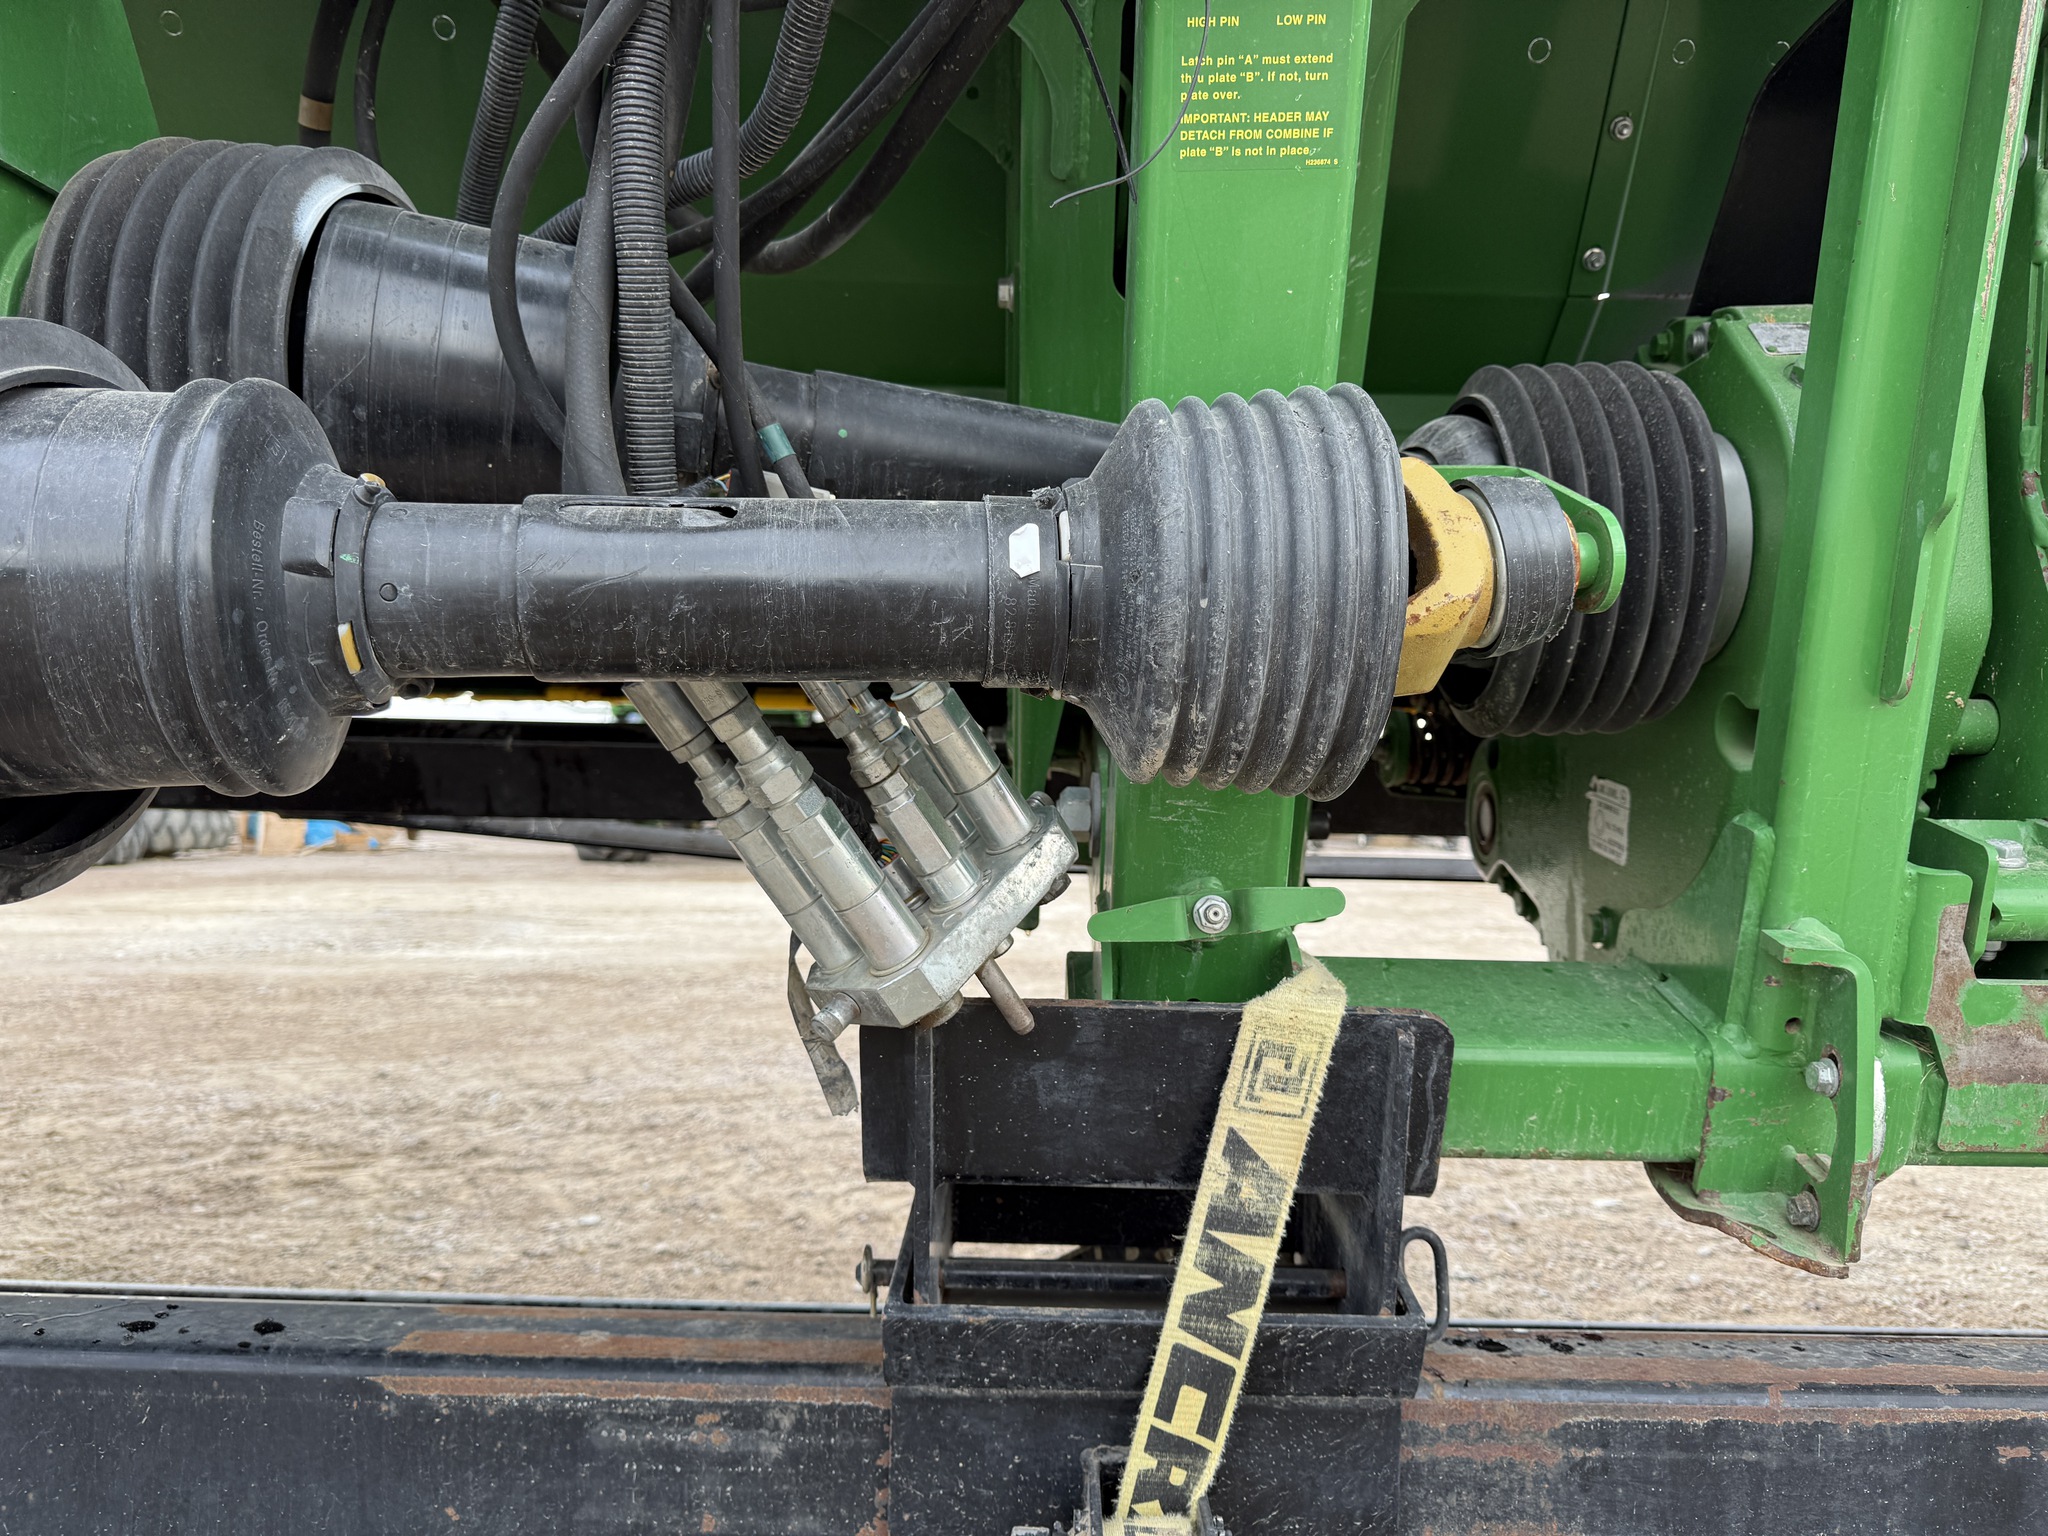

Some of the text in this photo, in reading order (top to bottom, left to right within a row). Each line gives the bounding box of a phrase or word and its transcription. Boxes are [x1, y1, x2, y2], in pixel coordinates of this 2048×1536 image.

[1187, 16, 1239, 27] HIGH PIN
[1277, 14, 1326, 25] LOW PIN
[1182, 56, 1212, 66] Latch
[1217, 55, 1234, 67] pin
[1262, 54, 1290, 64] must
[1294, 54, 1333, 64] extend
[1181, 74, 1204, 83] thu
[1208, 73, 1236, 85] plate
[1268, 71, 1275, 81] If
[1279, 72, 1301, 82] not,
[1305, 71, 1328, 80] turn
[1181, 91, 1240, 102] pate over.
[1180, 111, 1329, 124] IMPORTANT: HEADER MAY
[1180, 128, 1333, 140] DETACH FROM COMBINE IF
[1180, 147, 1206, 159] plate
[1232, 146, 1241, 156] is
[1245, 147, 1262, 156] not
[1267, 146, 1276, 155] in
[251, 519, 265, 600] Bestell-Nr.
[1131, 1126, 1290, 1518] ANCR
